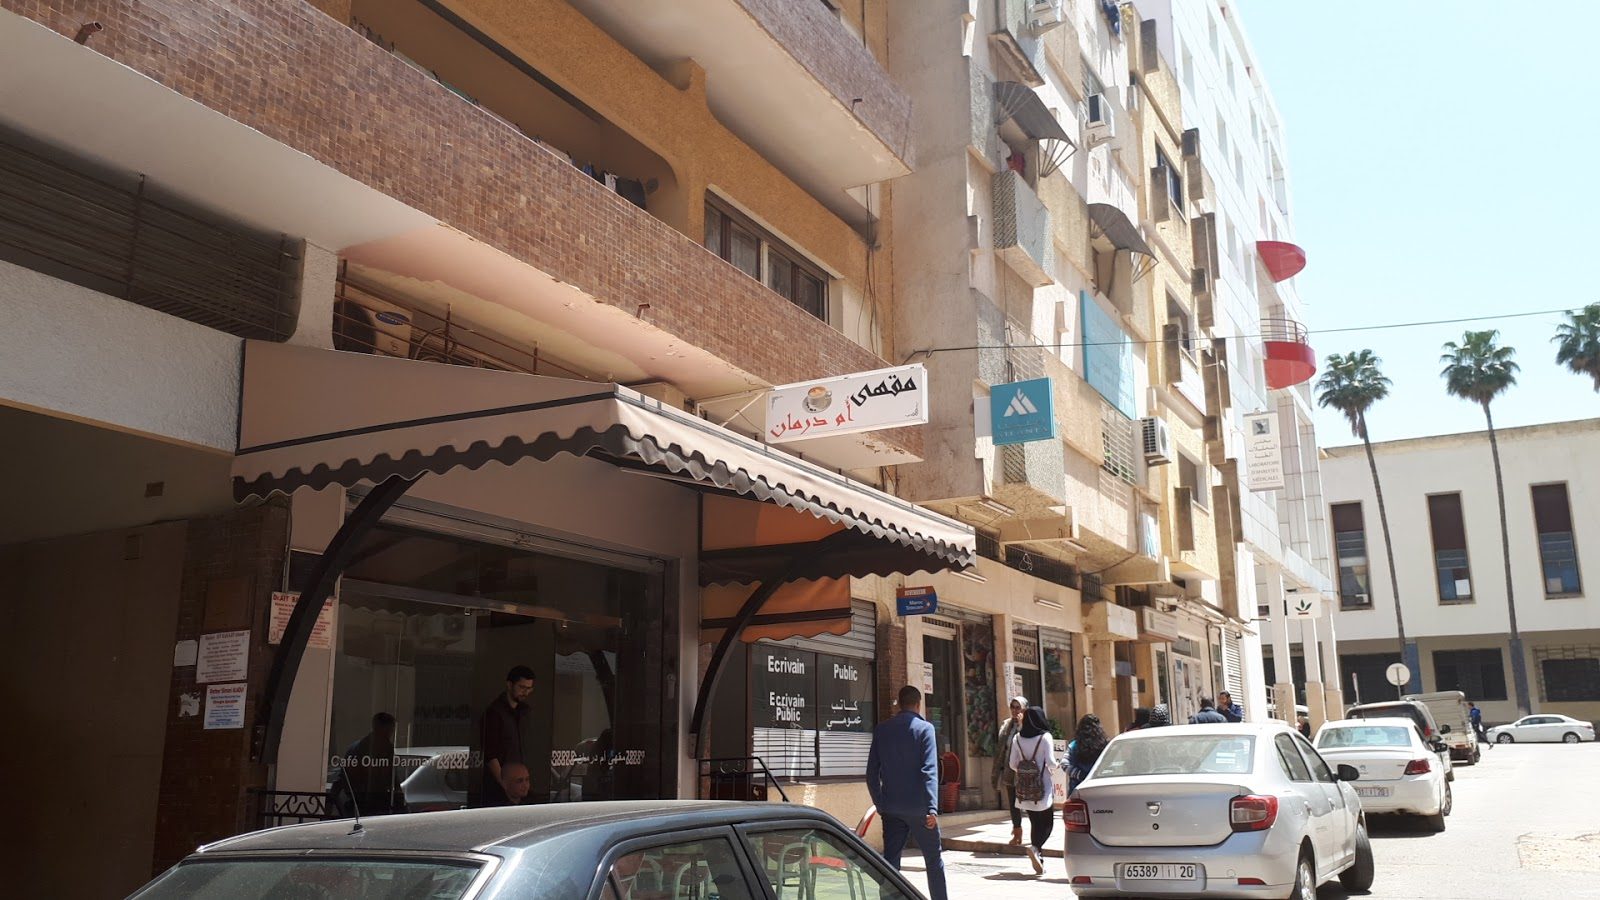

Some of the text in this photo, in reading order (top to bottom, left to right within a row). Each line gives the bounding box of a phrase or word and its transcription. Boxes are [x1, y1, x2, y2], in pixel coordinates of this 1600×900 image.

[850, 374, 917, 407] مقهى
[770, 395, 854, 438] أم درمان
[767, 655, 805, 675] Ecrivain
[833, 663, 858, 681] Public
[769, 691, 805, 708] Ecrivain
[776, 707, 801, 722] Public
[826, 715, 862, 731] عمومي
[330, 755, 358, 767] Café
[361, 755, 389, 767] Oum
[1126, 865, 1158, 878] 65389
[1180, 865, 1194, 878] 20
